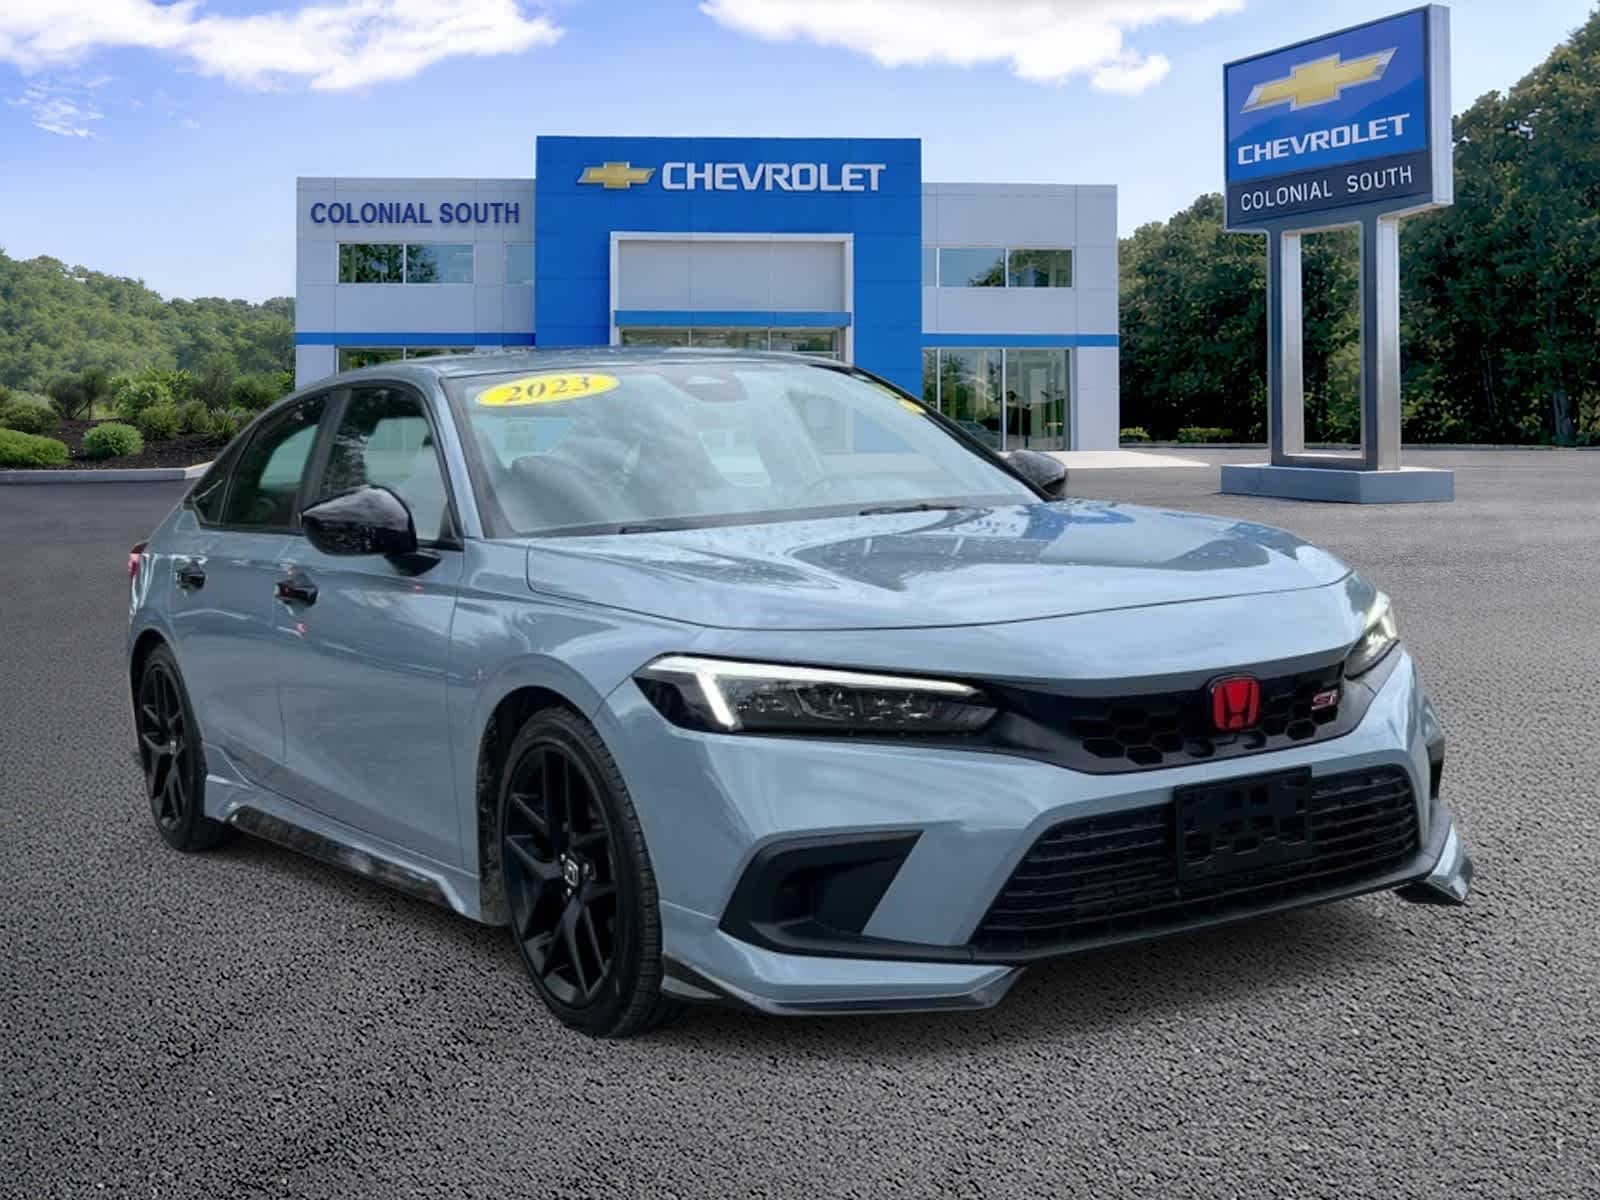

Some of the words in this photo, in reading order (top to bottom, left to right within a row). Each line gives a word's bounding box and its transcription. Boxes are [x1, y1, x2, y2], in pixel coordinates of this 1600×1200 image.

[1237, 113, 1410, 165] CHEVROLET
[661, 162, 887, 191] CHEVROLET
[1241, 180, 1333, 211] COLONIAL
[1346, 165, 1413, 194] SOUTH
[310, 202, 432, 224] COLONIAL
[439, 202, 520, 224] SOUTH
[504, 374, 593, 403] 2023
